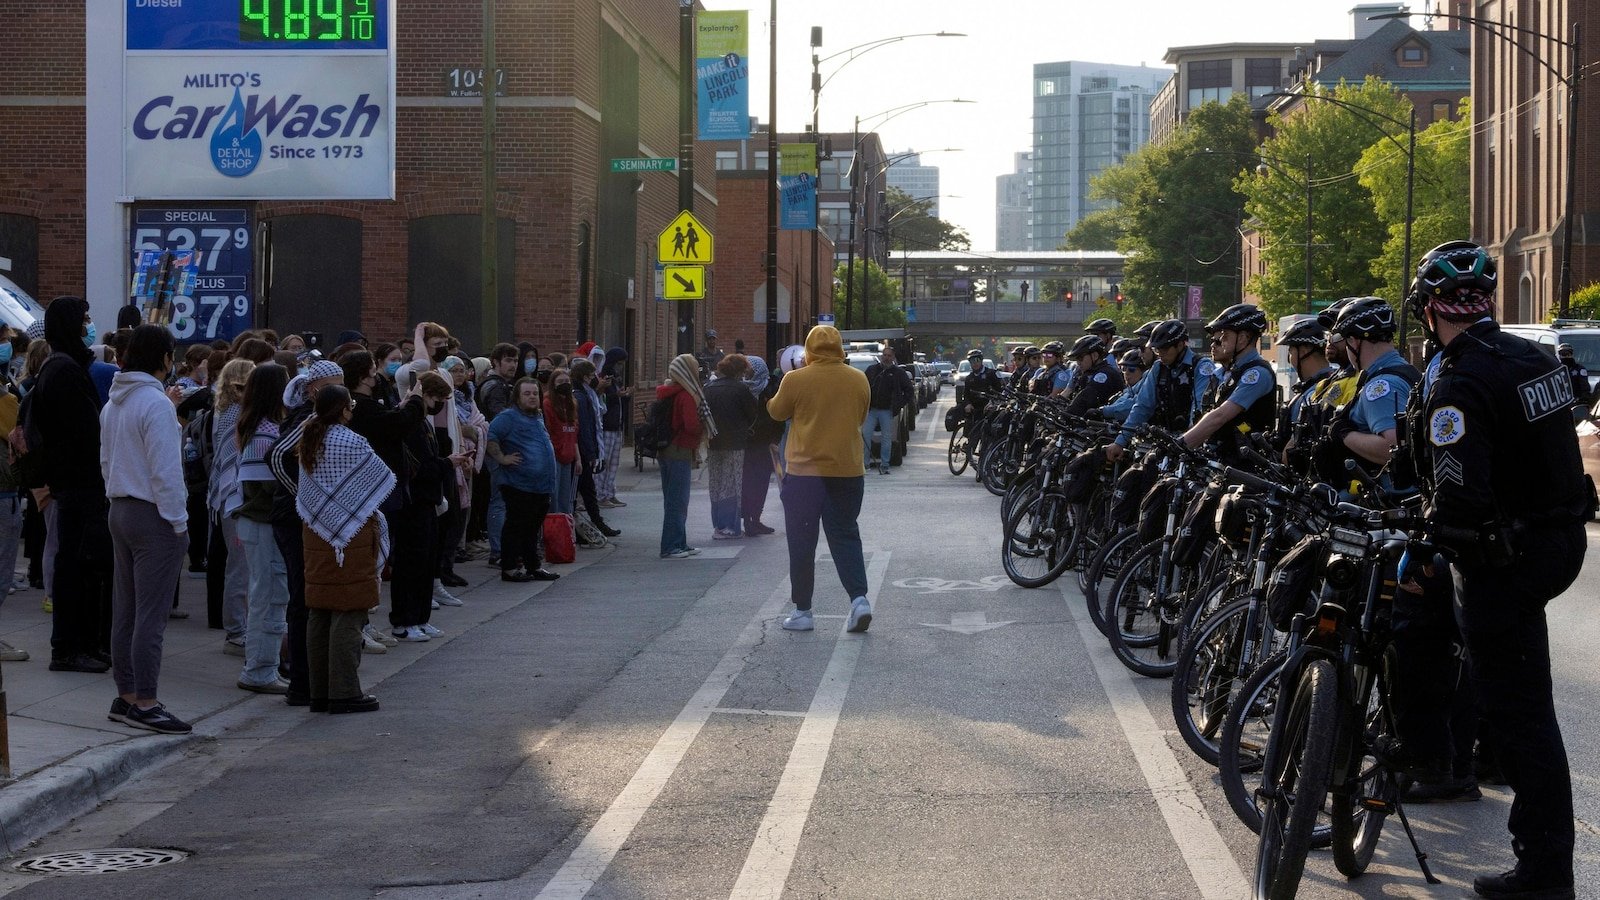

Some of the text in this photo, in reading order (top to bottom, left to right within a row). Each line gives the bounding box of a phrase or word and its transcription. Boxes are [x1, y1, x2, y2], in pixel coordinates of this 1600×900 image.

[135, 0, 182, 8] Diesel
[697, 54, 738, 79] MAKE it
[183, 72, 261, 88] MILITO'S
[708, 84, 739, 104] PARK
[132, 93, 381, 140] Car Wash
[231, 137, 240, 147] &
[217, 148, 254, 158] DETAIL
[269, 145, 363, 159] Since 1973
[220, 158, 252, 169] SHOP
[620, 160, 663, 170] SEMINARY
[164, 211, 217, 222] SPECIAL
[234, 227, 249, 249] 9
[194, 278, 226, 289] PLUS
[233, 295, 249, 317] 9
[1524, 371, 1573, 416] POLICE
[1433, 410, 1459, 428] CHICAGO
[1435, 430, 1458, 443] POLICE
